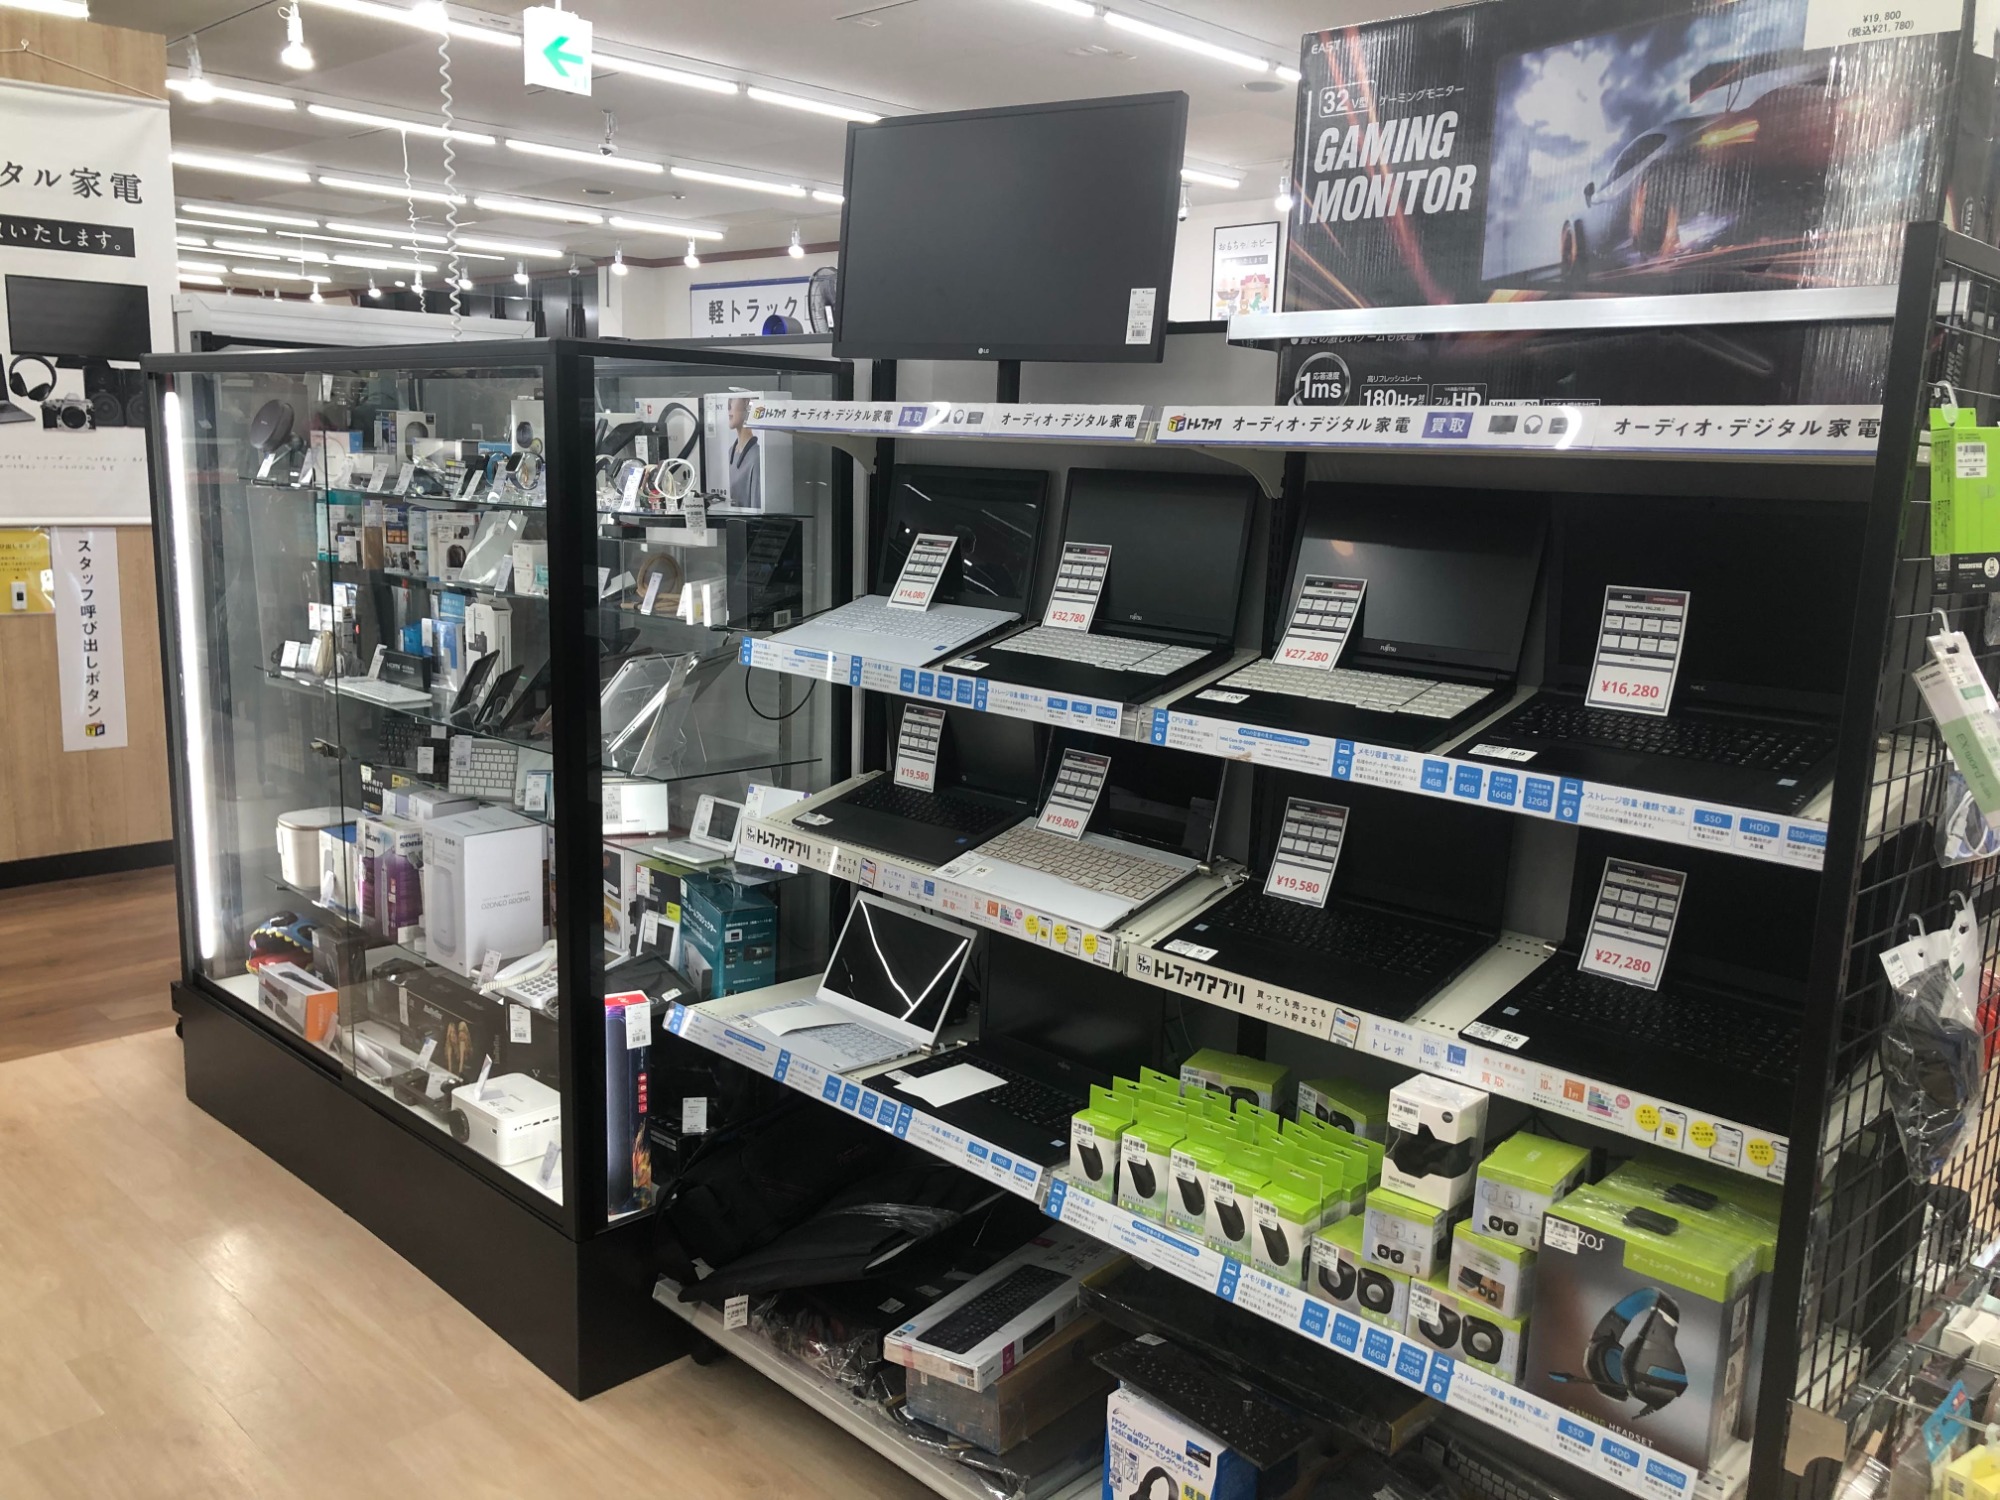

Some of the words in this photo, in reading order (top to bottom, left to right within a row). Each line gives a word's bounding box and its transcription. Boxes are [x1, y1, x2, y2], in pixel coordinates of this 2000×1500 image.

[1863, 10, 1902, 23] ¥19,800
[1847, 20, 1915, 38] (税込¥21,780)
[1379, 84, 1465, 106] ゲーミングモニター
[1314, 110, 1459, 173] GAMING
[0, 161, 143, 204] タル家電
[1309, 164, 1477, 224] MONITOR
[0, 223, 121, 251] いたします。
[708, 296, 798, 325] 軽トラック
[1312, 371, 1341, 381] 応答速度
[1366, 374, 1423, 383] 高リフレッシュレート
[1300, 372, 1342, 399] 1ms
[1363, 389, 1417, 406] 180Hz
[792, 409, 894, 423] オーディオ・デジタル家電
[902, 410, 923, 423] 買取
[1001, 413, 1138, 430] オーディオ・デジタル家電
[1232, 416, 1411, 433] オーディオ・デジタル家電
[1430, 416, 1465, 433] 買取
[1613, 417, 1881, 439] オーディオ・デジタル家電
[1052, 611, 1086, 623] ¥32,780
[77, 539, 102, 718] スタッフ呼び出しボタン
[1285, 648, 1329, 662] ¥27,280
[1919, 671, 1942, 682] CASIO
[1601, 680, 1660, 699] ¥16,280
[1358, 748, 1409, 762] メモリ容量で選ぶ
[901, 767, 930, 781] ¥19,580
[1425, 777, 1442, 788] 4GB
[1458, 784, 1476, 794] 8GB
[1491, 789, 1513, 800] 16GB
[1526, 796, 1549, 807] 32GB
[1587, 791, 1685, 815] ストレージ容量・種類で選ぶ
[1046, 813, 1079, 830] ¥19,800
[1703, 814, 1722, 824] SSD
[1748, 822, 1770, 833] HDD
[756, 828, 811, 861] トレファクアプリ
[1276, 875, 1320, 894] ¥19,580
[1137, 954, 1148, 964] トレ
[1594, 949, 1651, 973] ¥27,280
[1153, 958, 1245, 1004] トレファクアプリ
[1256, 989, 1327, 1018] 買っても売っても
[1256, 1001, 1323, 1030] ポイント貯まる!
[1374, 1023, 1414, 1041] 買って貯める
[1372, 1038, 1405, 1056] トレポ
[1481, 1071, 1505, 1088] 買取
[1633, 1253, 1716, 1289] ゲーミングヘッドセット
[1243, 1272, 1292, 1299] メモリ容量で選ぶ
[1304, 1318, 1321, 1332] 4GB
[1336, 1332, 1352, 1346] 8GB
[1367, 1347, 1387, 1362] 16GB
[1398, 1361, 1420, 1377] 32GB
[1457, 1372, 1550, 1420] ストレージ容量・種類で選ぶ
[1567, 1425, 1585, 1439] SSD
[1568, 1405, 1607, 1428] GAMING
[1608, 1422, 1655, 1449] HEADSET
[1609, 1445, 1630, 1461] HDD
